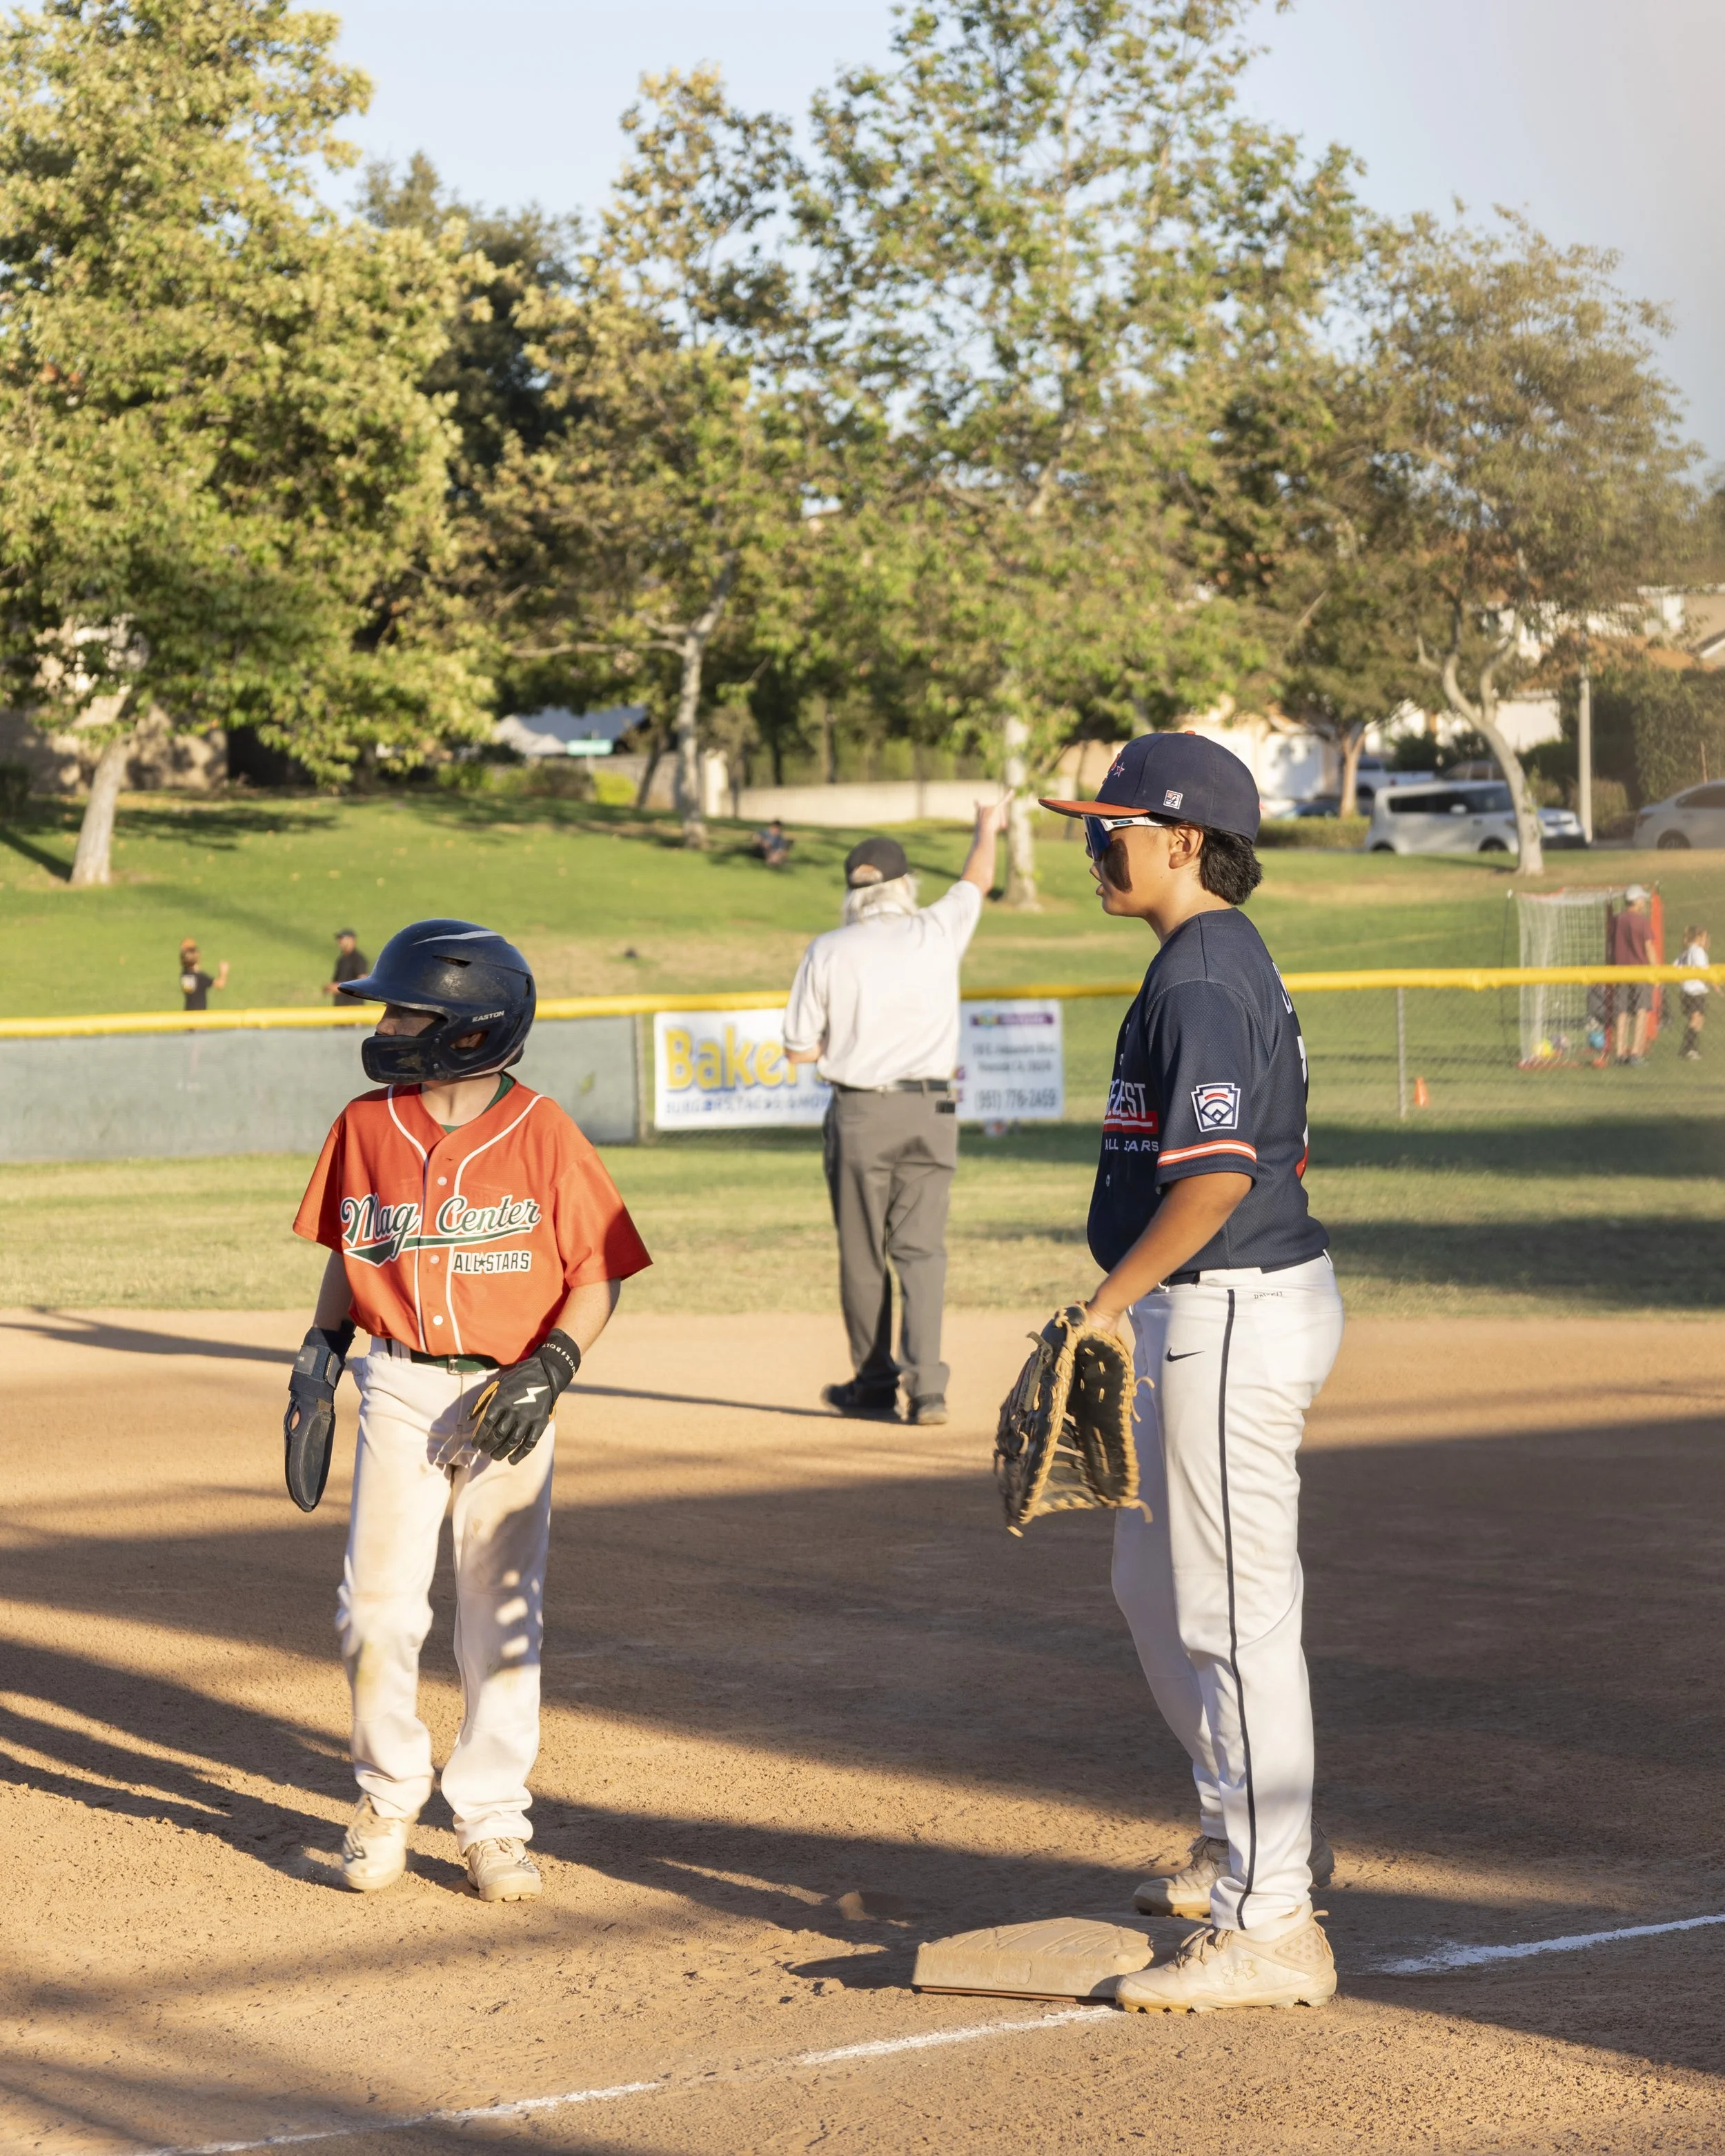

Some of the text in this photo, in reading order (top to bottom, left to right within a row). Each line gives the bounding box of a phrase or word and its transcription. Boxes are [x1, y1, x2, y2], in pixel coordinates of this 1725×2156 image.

[472, 1010, 504, 1022] EASTON
[341, 1193, 542, 1260] Mag Center
